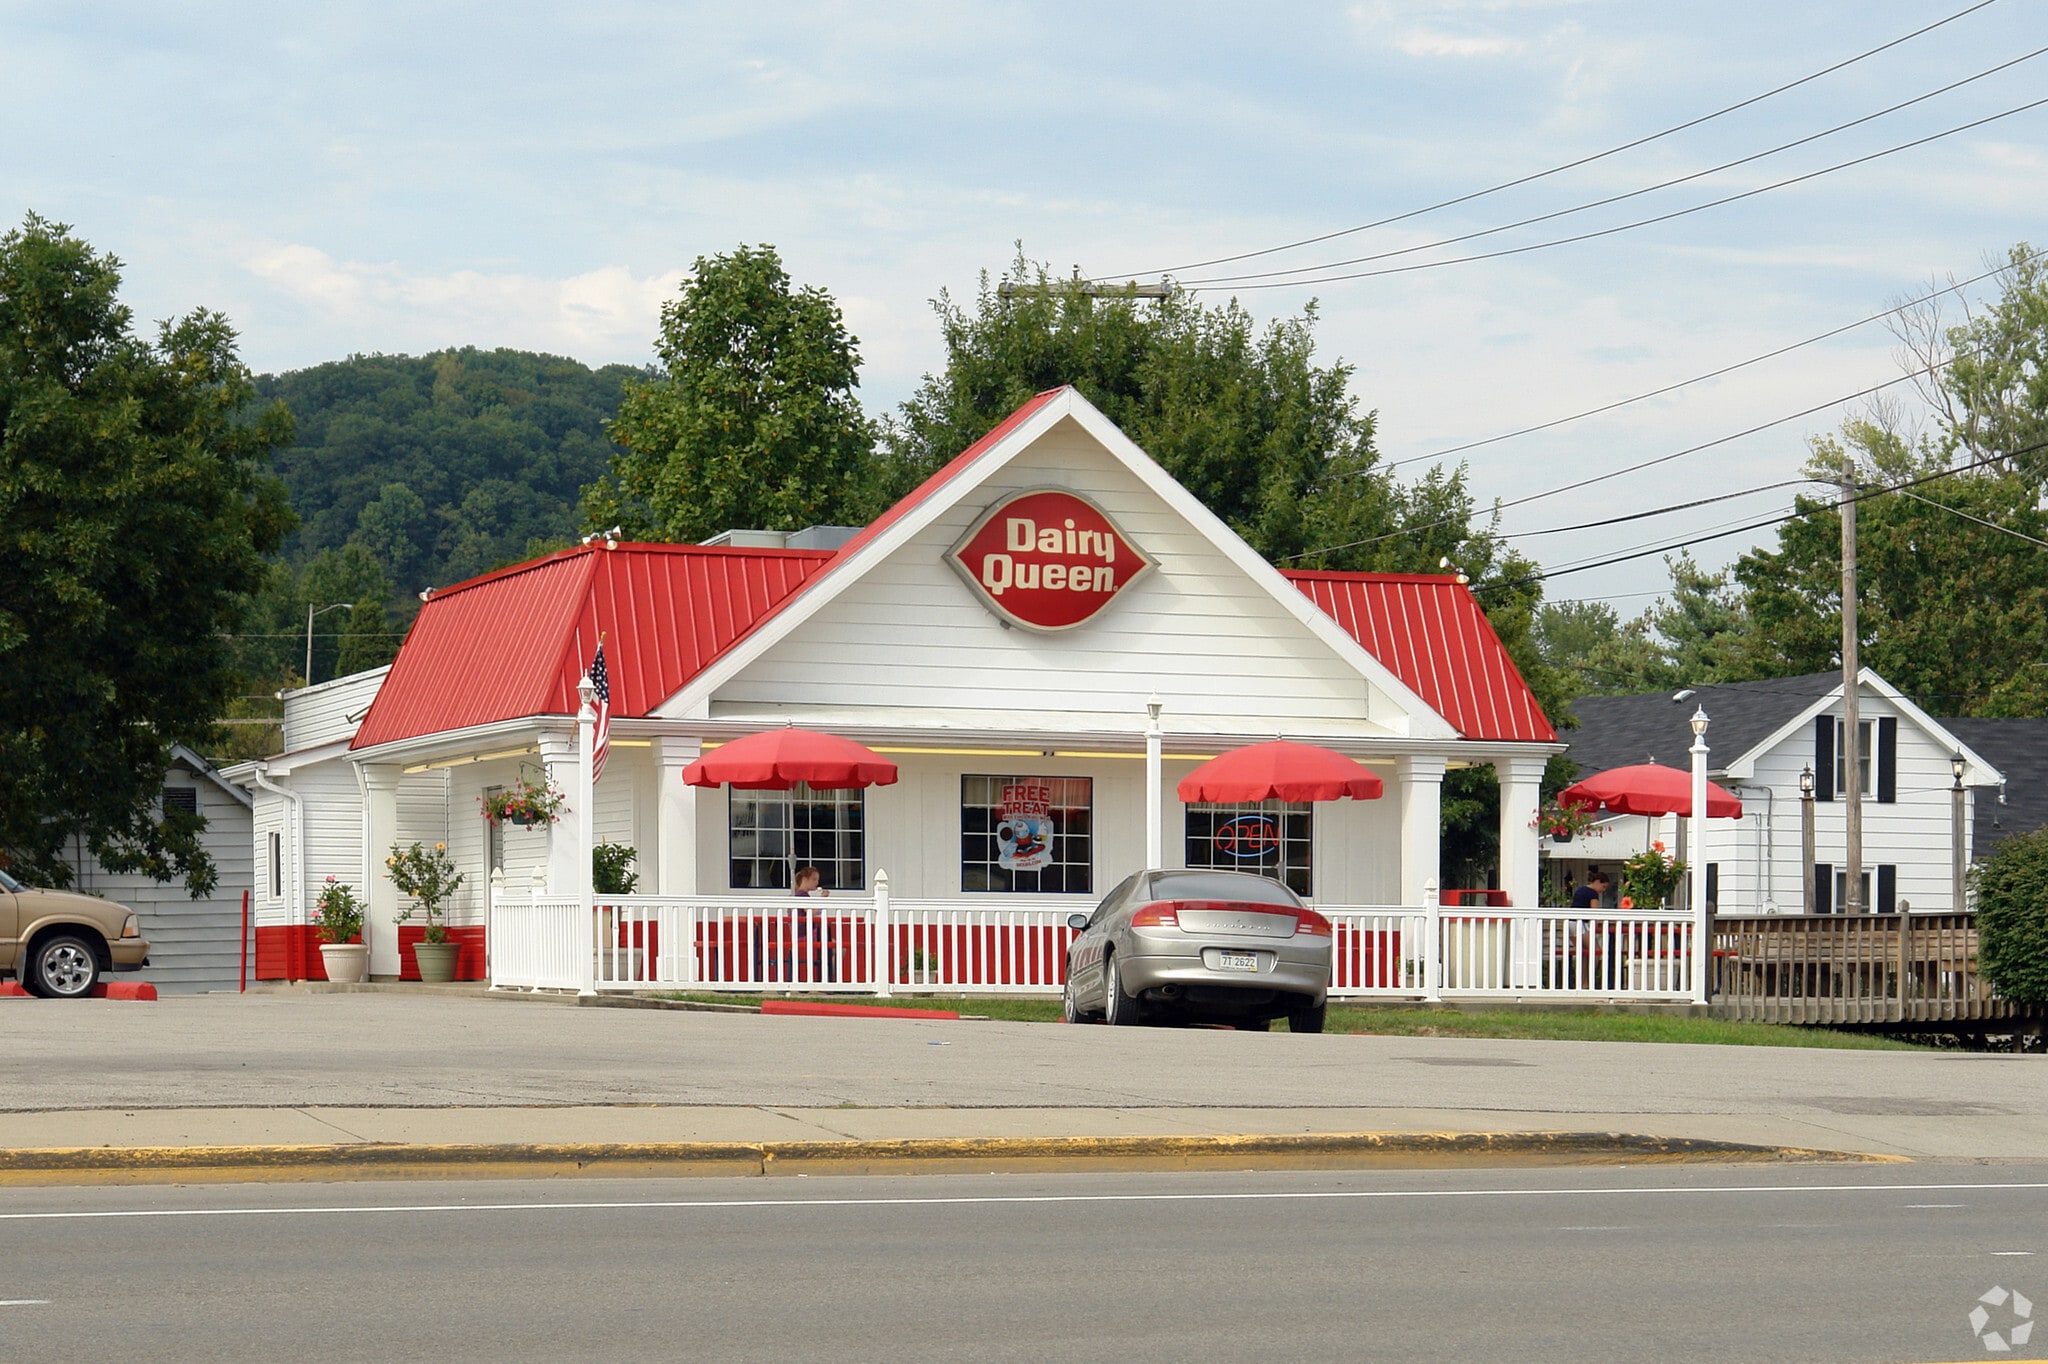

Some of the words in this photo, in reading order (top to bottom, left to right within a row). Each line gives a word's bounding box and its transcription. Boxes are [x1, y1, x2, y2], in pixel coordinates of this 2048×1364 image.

[1006, 518, 1115, 563] Dairy
[982, 554, 1115, 595] Queen
[1002, 785, 1050, 802] FREE
[1004, 802, 1049, 815] TREAT
[1215, 824, 1280, 850] OPEN
